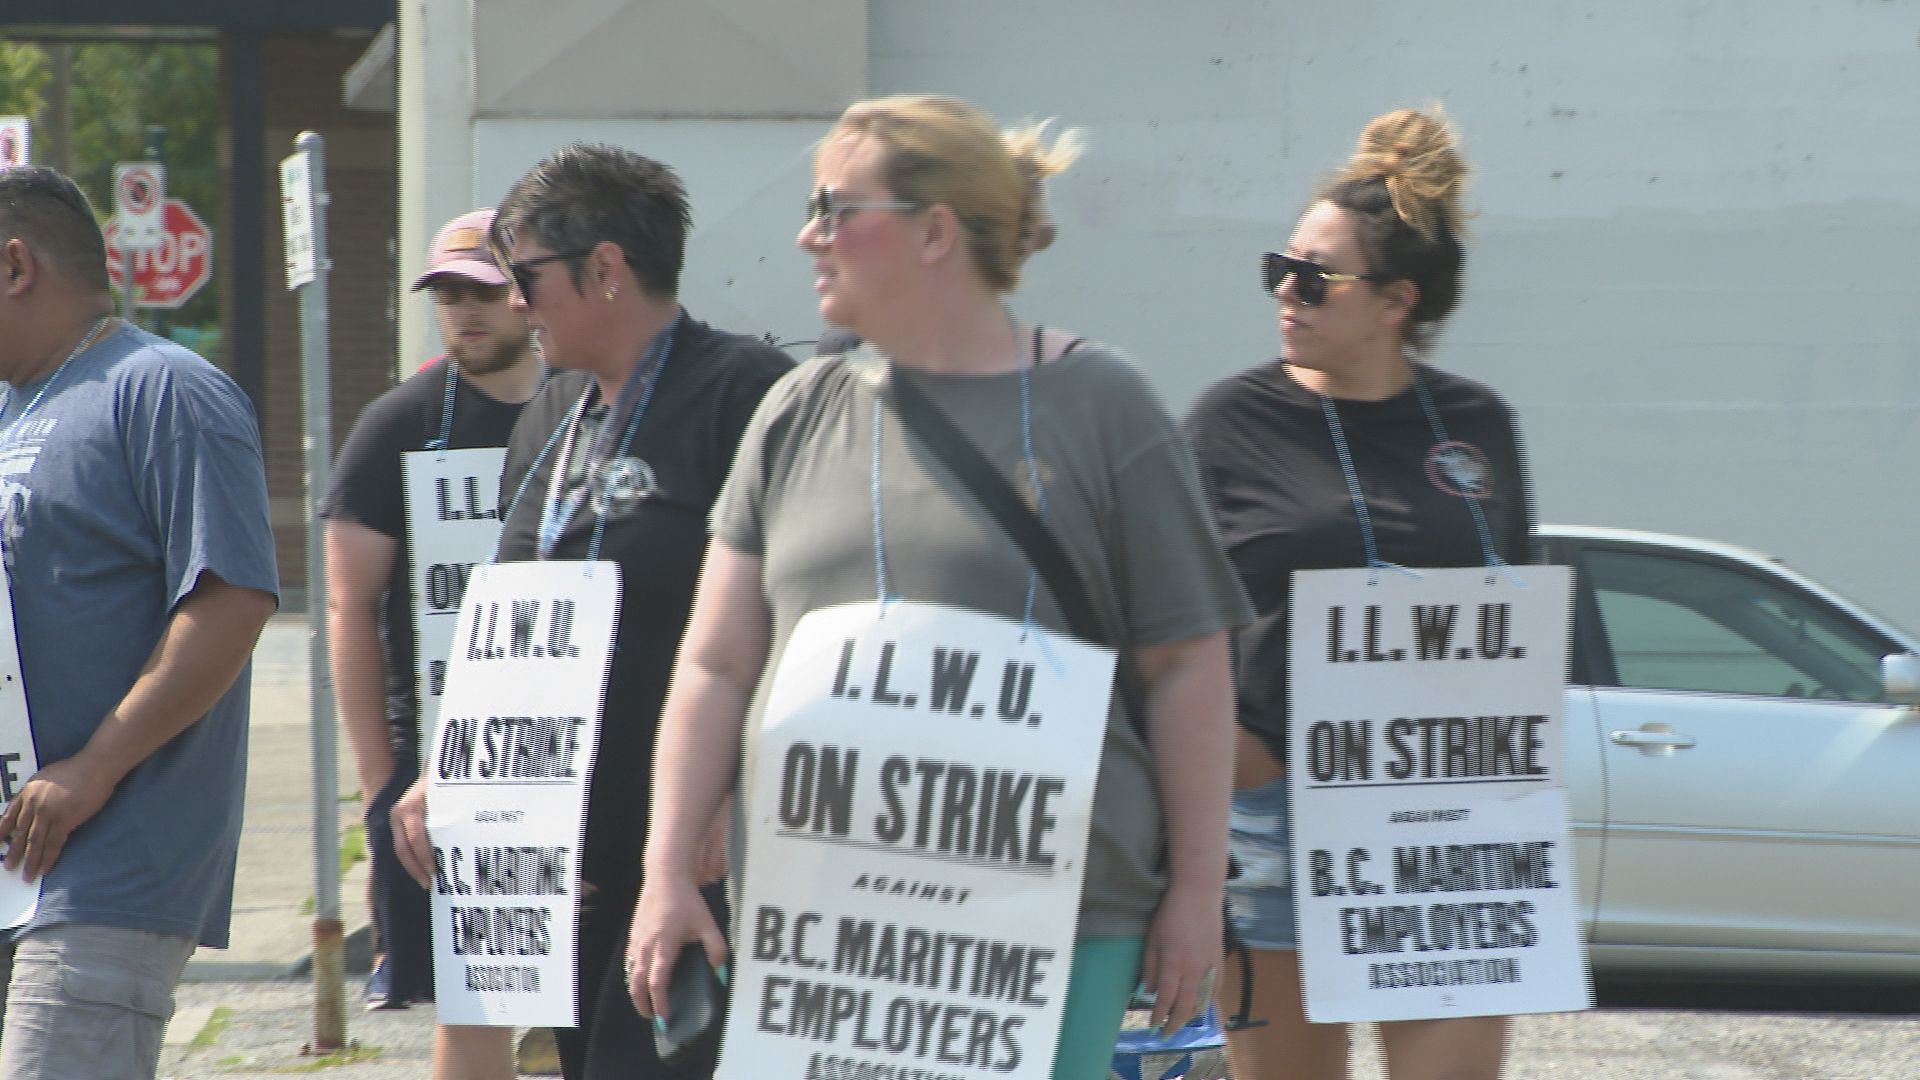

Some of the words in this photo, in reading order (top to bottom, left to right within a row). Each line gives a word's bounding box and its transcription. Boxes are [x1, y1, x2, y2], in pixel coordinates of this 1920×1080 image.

[467, 599, 581, 661] I.L.W.U.
[1326, 602, 1528, 664] I.L.W.U.
[831, 637, 1043, 727] I.L.W.U.
[438, 719, 478, 780] ON
[479, 717, 587, 779] STRIKE
[1306, 720, 1374, 782] ON
[1384, 714, 1551, 780] STRIKE
[474, 810, 525, 824] AGAINST
[779, 741, 859, 837] ON
[873, 754, 1065, 867] STRIKE
[1387, 808, 1472, 825] AGAINST
[433, 846, 472, 895] B.C.
[474, 846, 571, 895] MARITIME
[853, 872, 973, 905] AGAINST
[1308, 846, 1385, 898] B.C.
[1392, 840, 1560, 894] MARITIME
[450, 906, 552, 956] EMPLOYERS
[1339, 900, 1540, 955] EMPLOYERS
[465, 965, 542, 993] ASSOCIATION
[752, 905, 830, 973] B.C.
[831, 916, 1056, 1009] MARITIME
[1368, 957, 1522, 991] ASSOCIATION
[757, 975, 1025, 1073] EMPLOYERS
